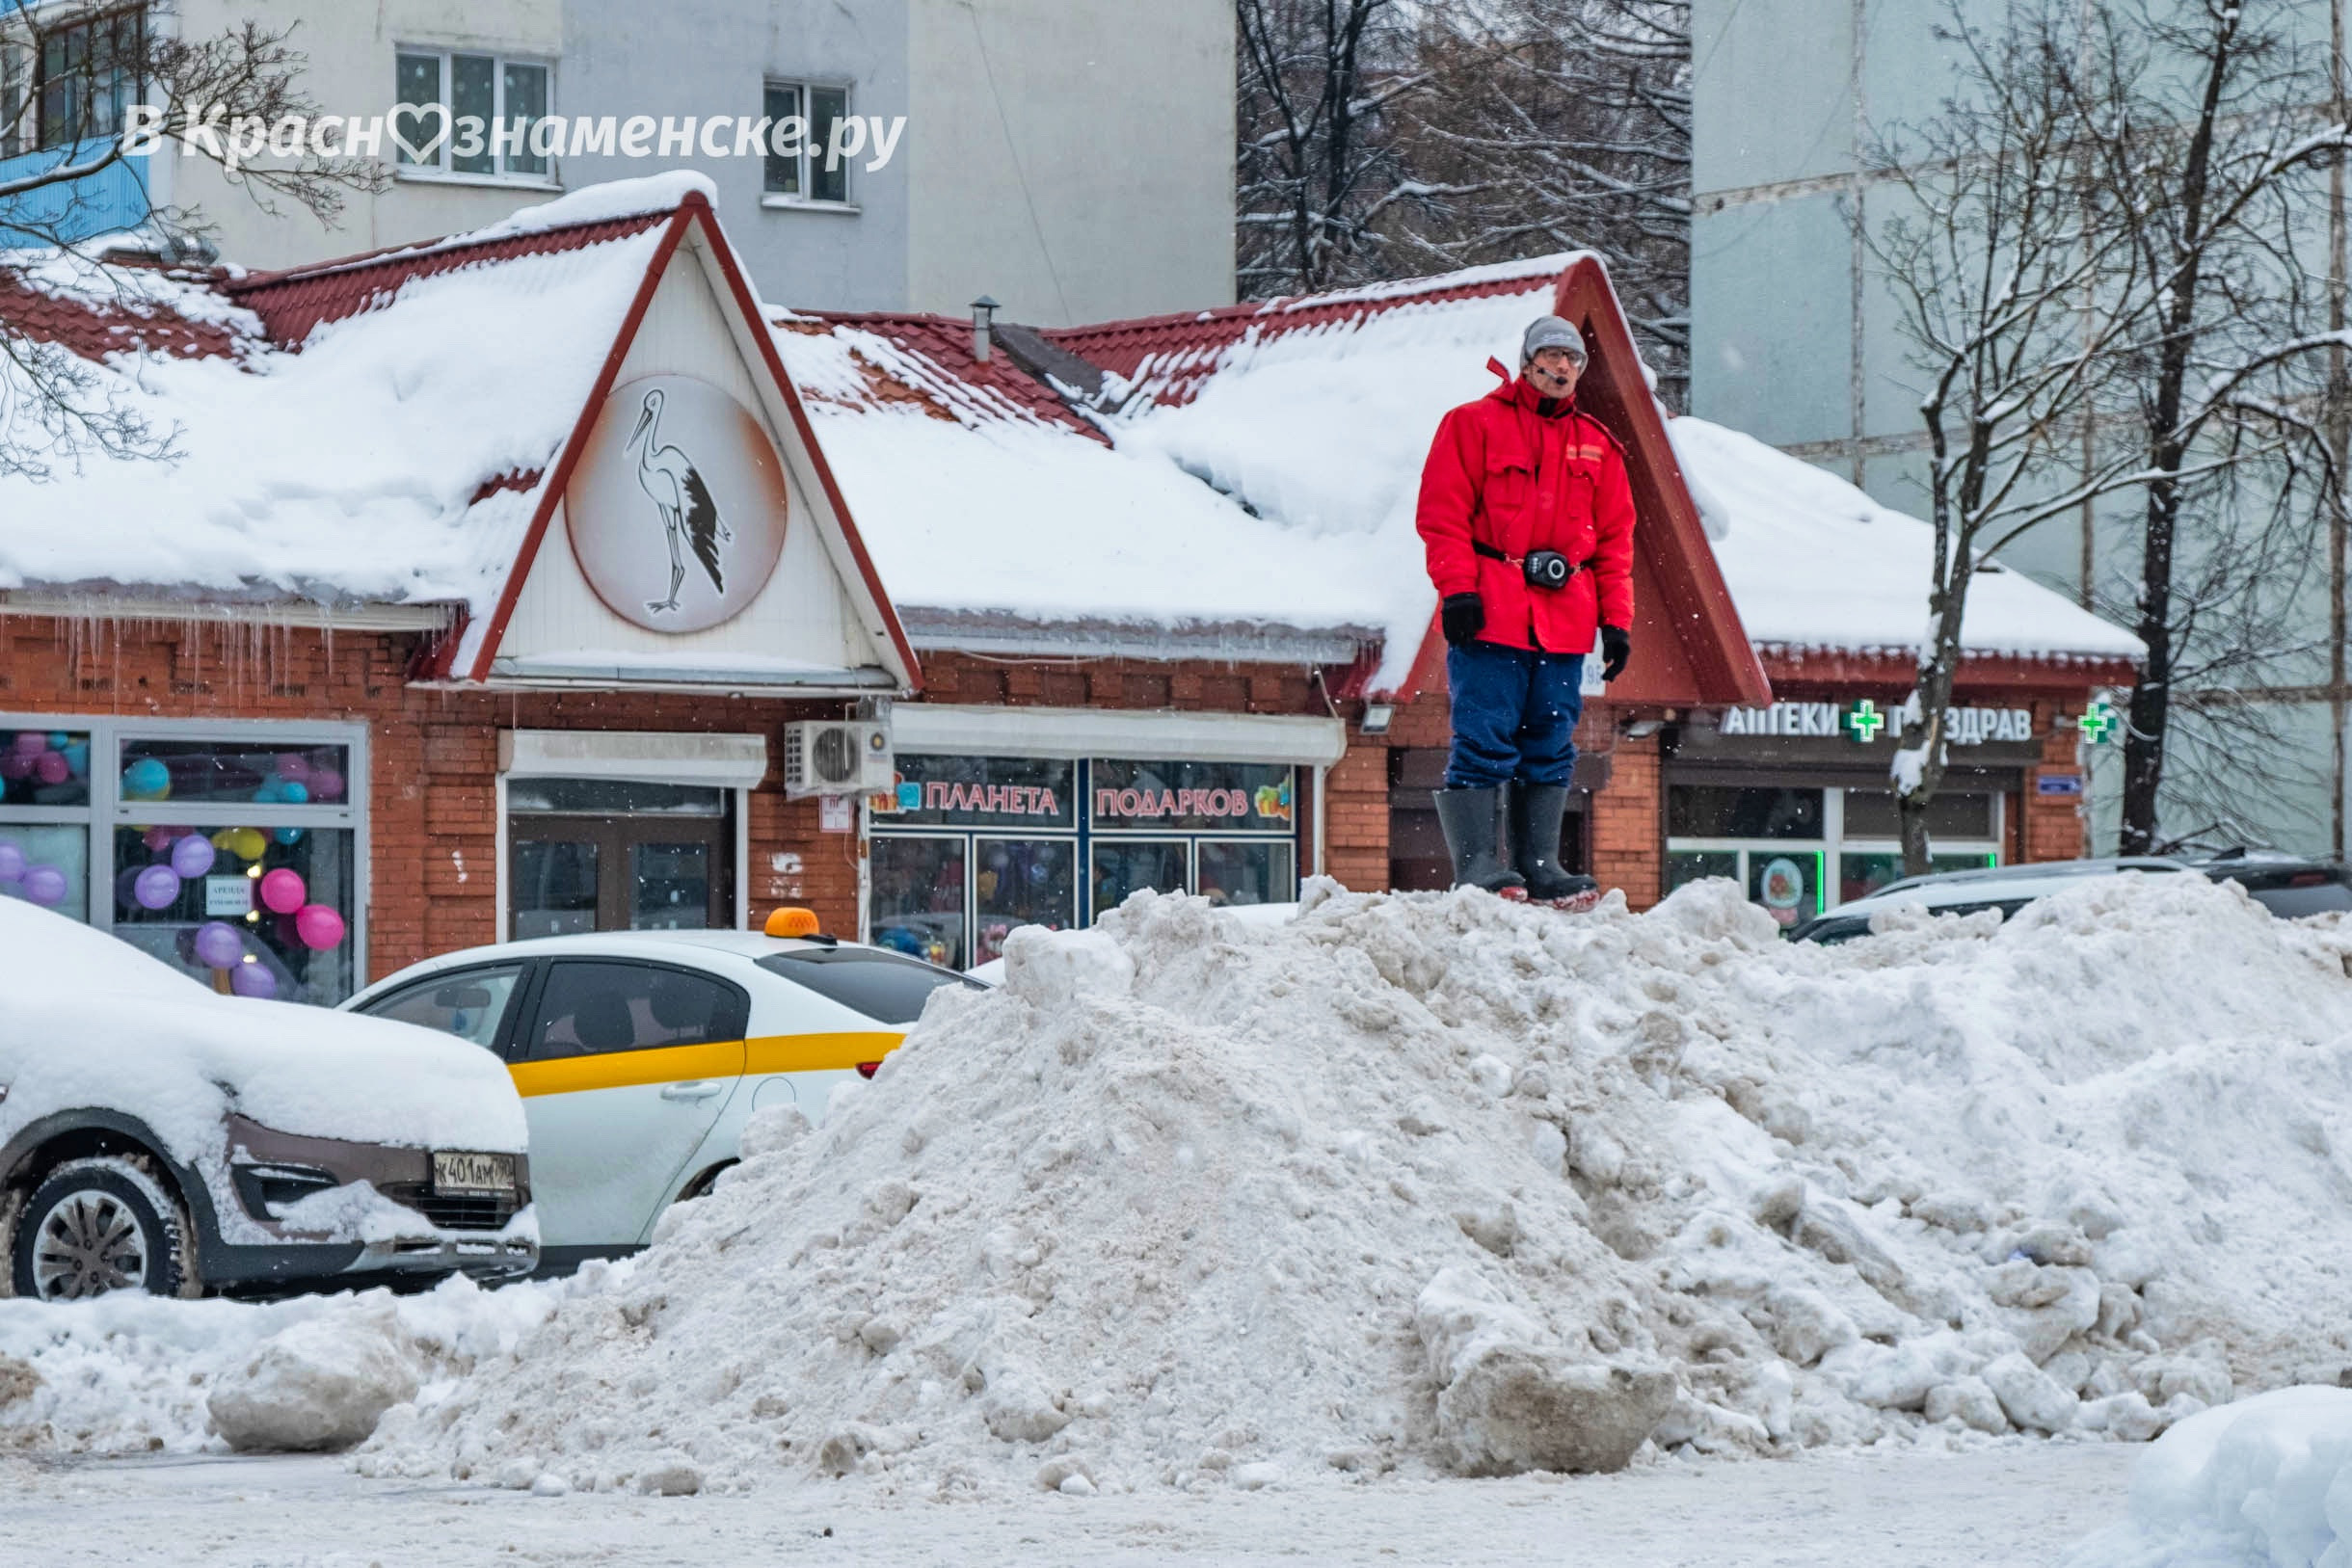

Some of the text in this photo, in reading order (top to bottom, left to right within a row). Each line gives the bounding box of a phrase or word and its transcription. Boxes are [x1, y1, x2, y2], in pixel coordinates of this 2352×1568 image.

[1720, 702, 2032, 745] АПТЕКИ ГЗДРАВ
[925, 781, 1248, 818] ПЛАНЕТА ПОДАРКОВ
